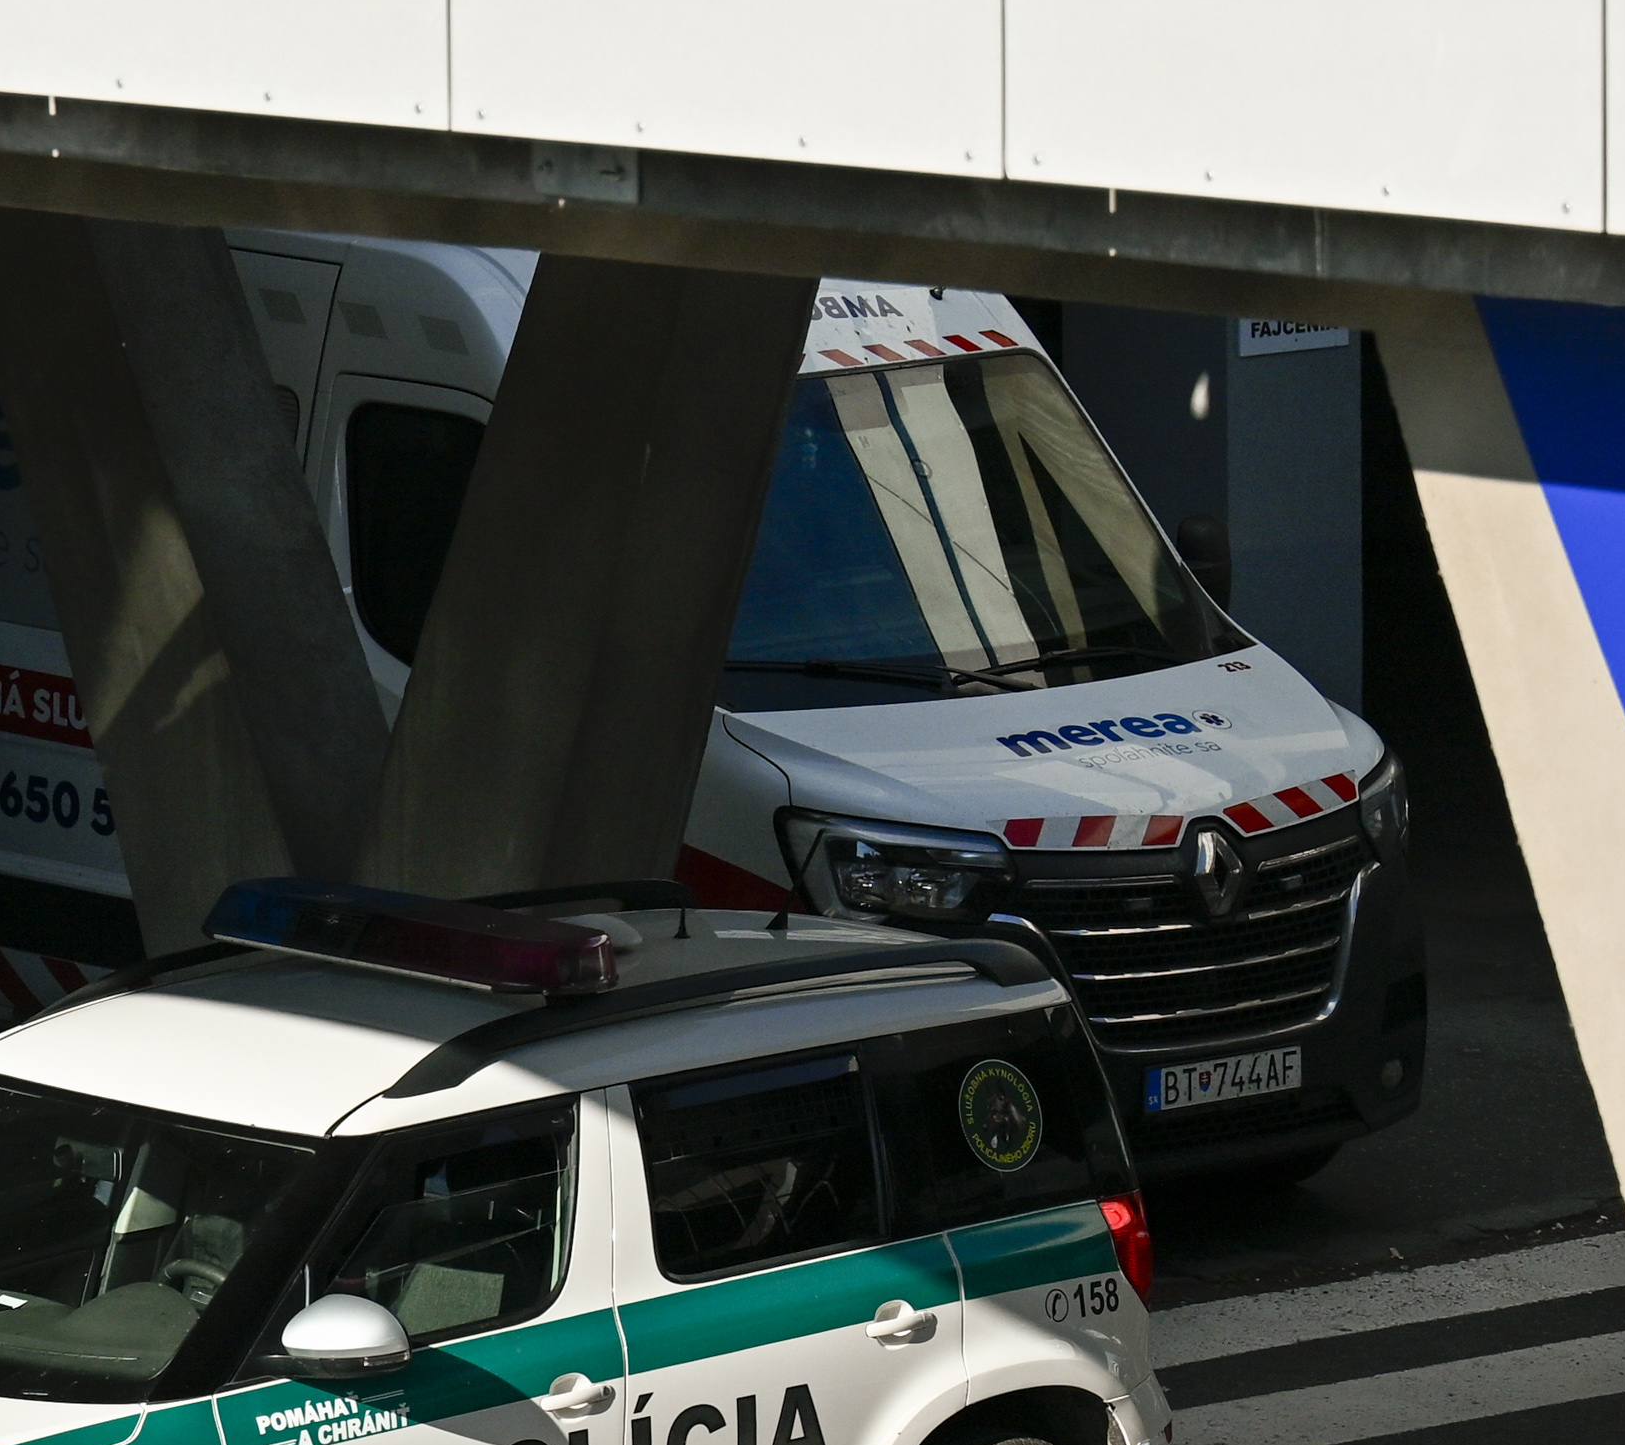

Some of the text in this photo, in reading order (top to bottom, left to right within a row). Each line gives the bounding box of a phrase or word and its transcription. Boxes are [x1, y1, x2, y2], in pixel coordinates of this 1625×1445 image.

[996, 712, 1202, 757] merea
[1078, 739, 1222, 770] spoľahnite sa
[1022, 1121, 1037, 1155] ZBORU
[1073, 1277, 1119, 1318] 158
[255, 1391, 359, 1435] POMÁHAŤ
[318, 1403, 410, 1445] CHRÁNIŤ
